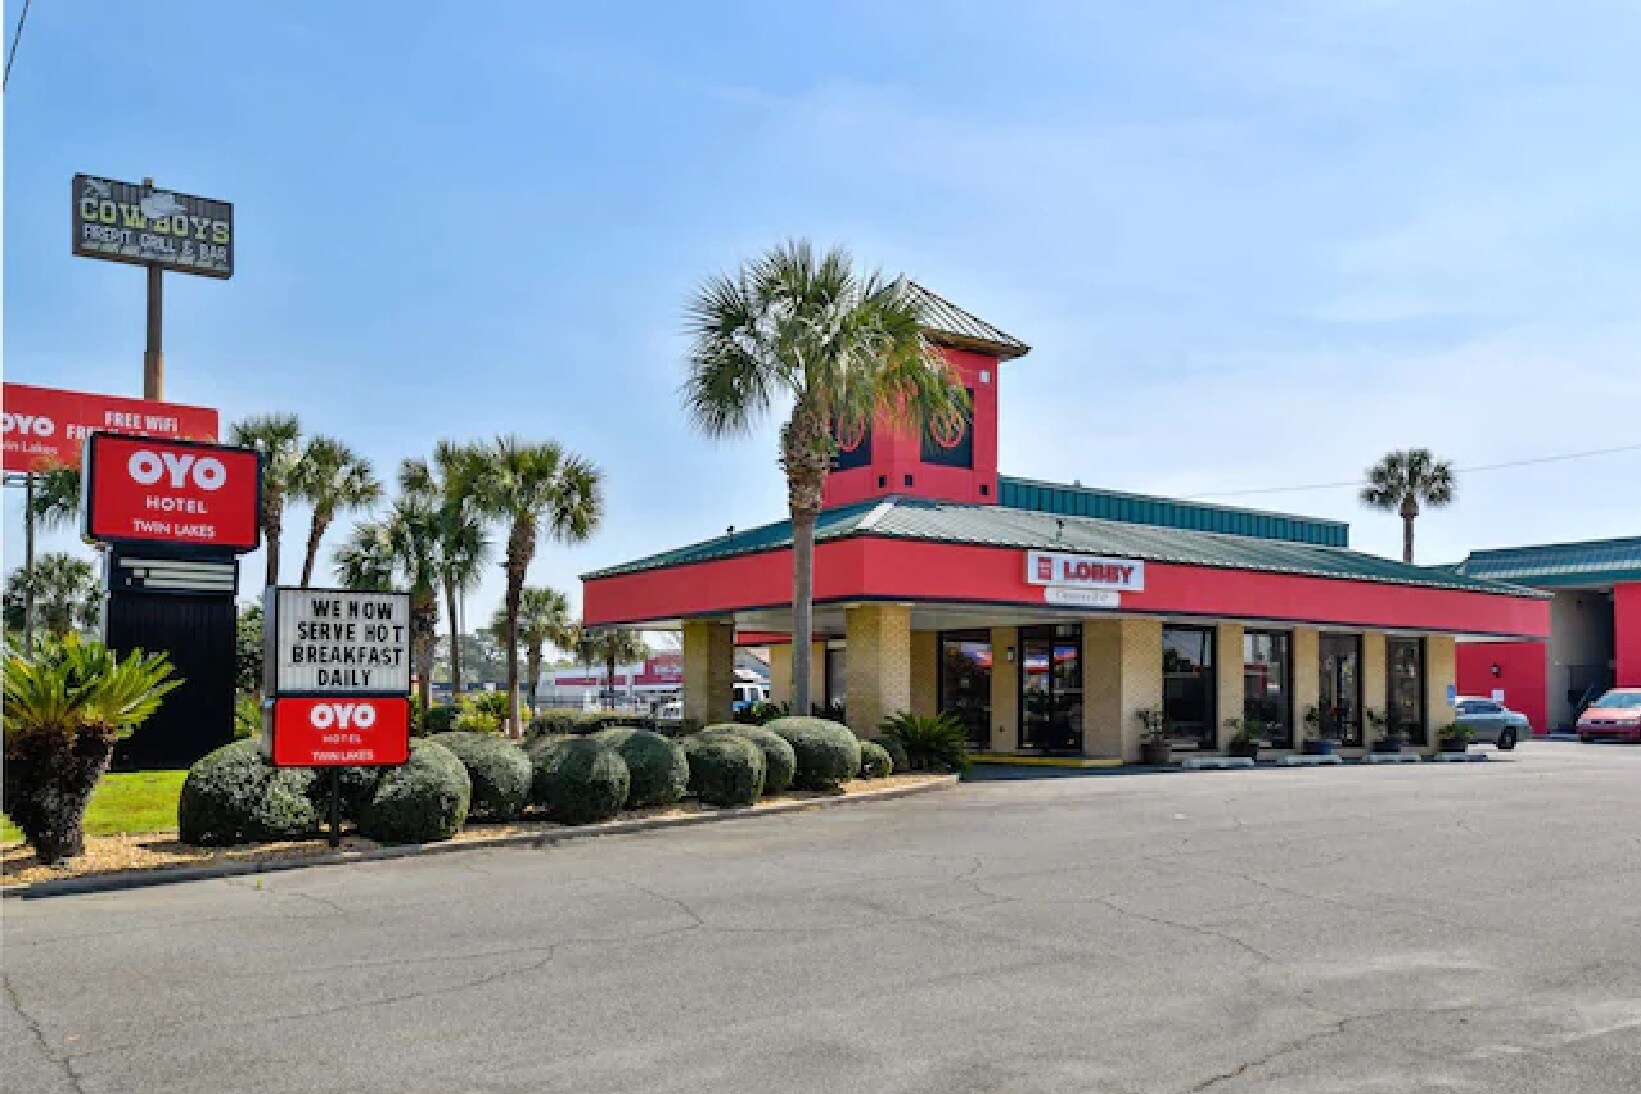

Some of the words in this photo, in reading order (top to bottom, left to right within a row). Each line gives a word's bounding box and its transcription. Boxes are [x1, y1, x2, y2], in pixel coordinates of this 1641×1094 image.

[104, 411, 142, 429] FREE
[128, 450, 226, 491] OYO
[146, 495, 207, 514] HOTEL
[133, 518, 171, 535] TWIN
[174, 522, 216, 539] LAKES
[311, 600, 340, 617] WE
[297, 621, 356, 642] SERVE
[364, 625, 404, 642] HOT
[291, 644, 404, 666] BREAKFAST
[317, 669, 371, 686] DAILY
[309, 703, 376, 729] OYO
